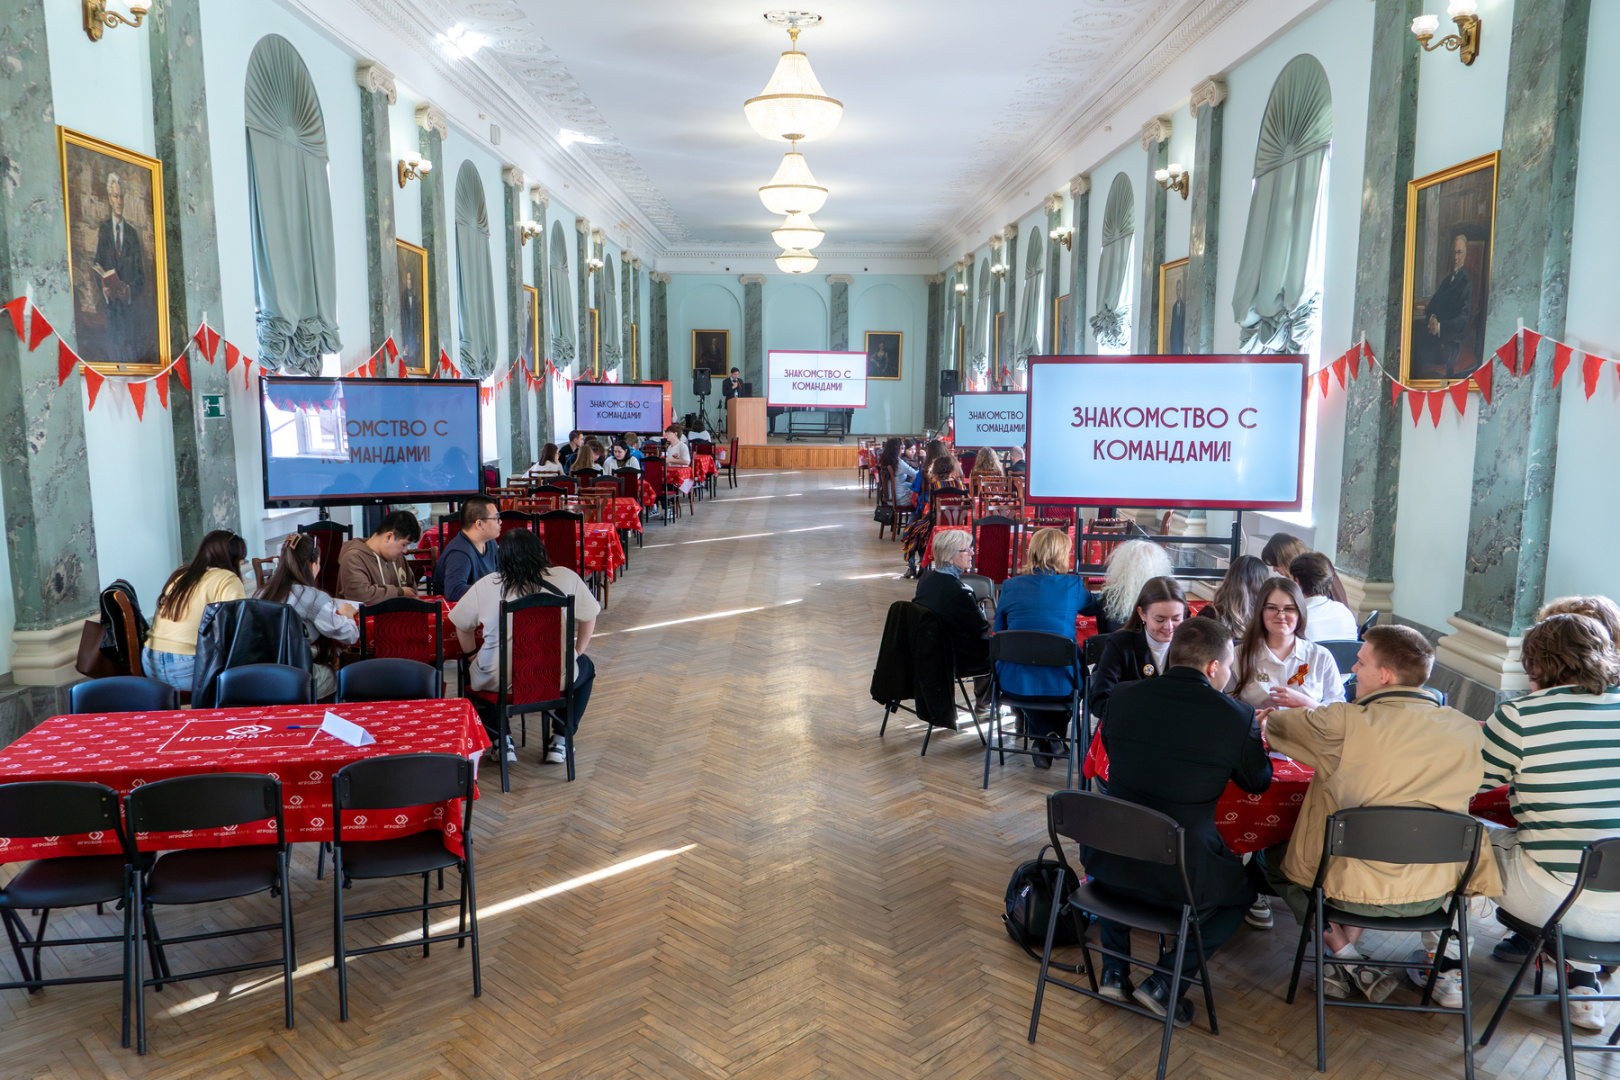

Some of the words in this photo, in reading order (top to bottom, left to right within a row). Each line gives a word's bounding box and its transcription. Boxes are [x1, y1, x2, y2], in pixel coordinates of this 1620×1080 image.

[784, 369, 841, 379] ЗНАКОМСТВО
[844, 370, 852, 379] С
[792, 381, 843, 391] КОМАНДАМИ!
[589, 400, 641, 409] ЗНАКОМСТВО
[642, 400, 650, 409] С
[968, 410, 1024, 420] ЗНАКОМСТВО
[1070, 407, 1229, 429] ЗНАКОМСТВО
[1238, 407, 1258, 429] С
[345, 419, 427, 438] ОМСТВО
[433, 419, 448, 437] С
[976, 423, 1025, 433] КОМАНДАМИ!
[1093, 439, 1232, 463] КОМАНДАМИ!
[179, 734, 259, 742] ИГРОВОЙ
